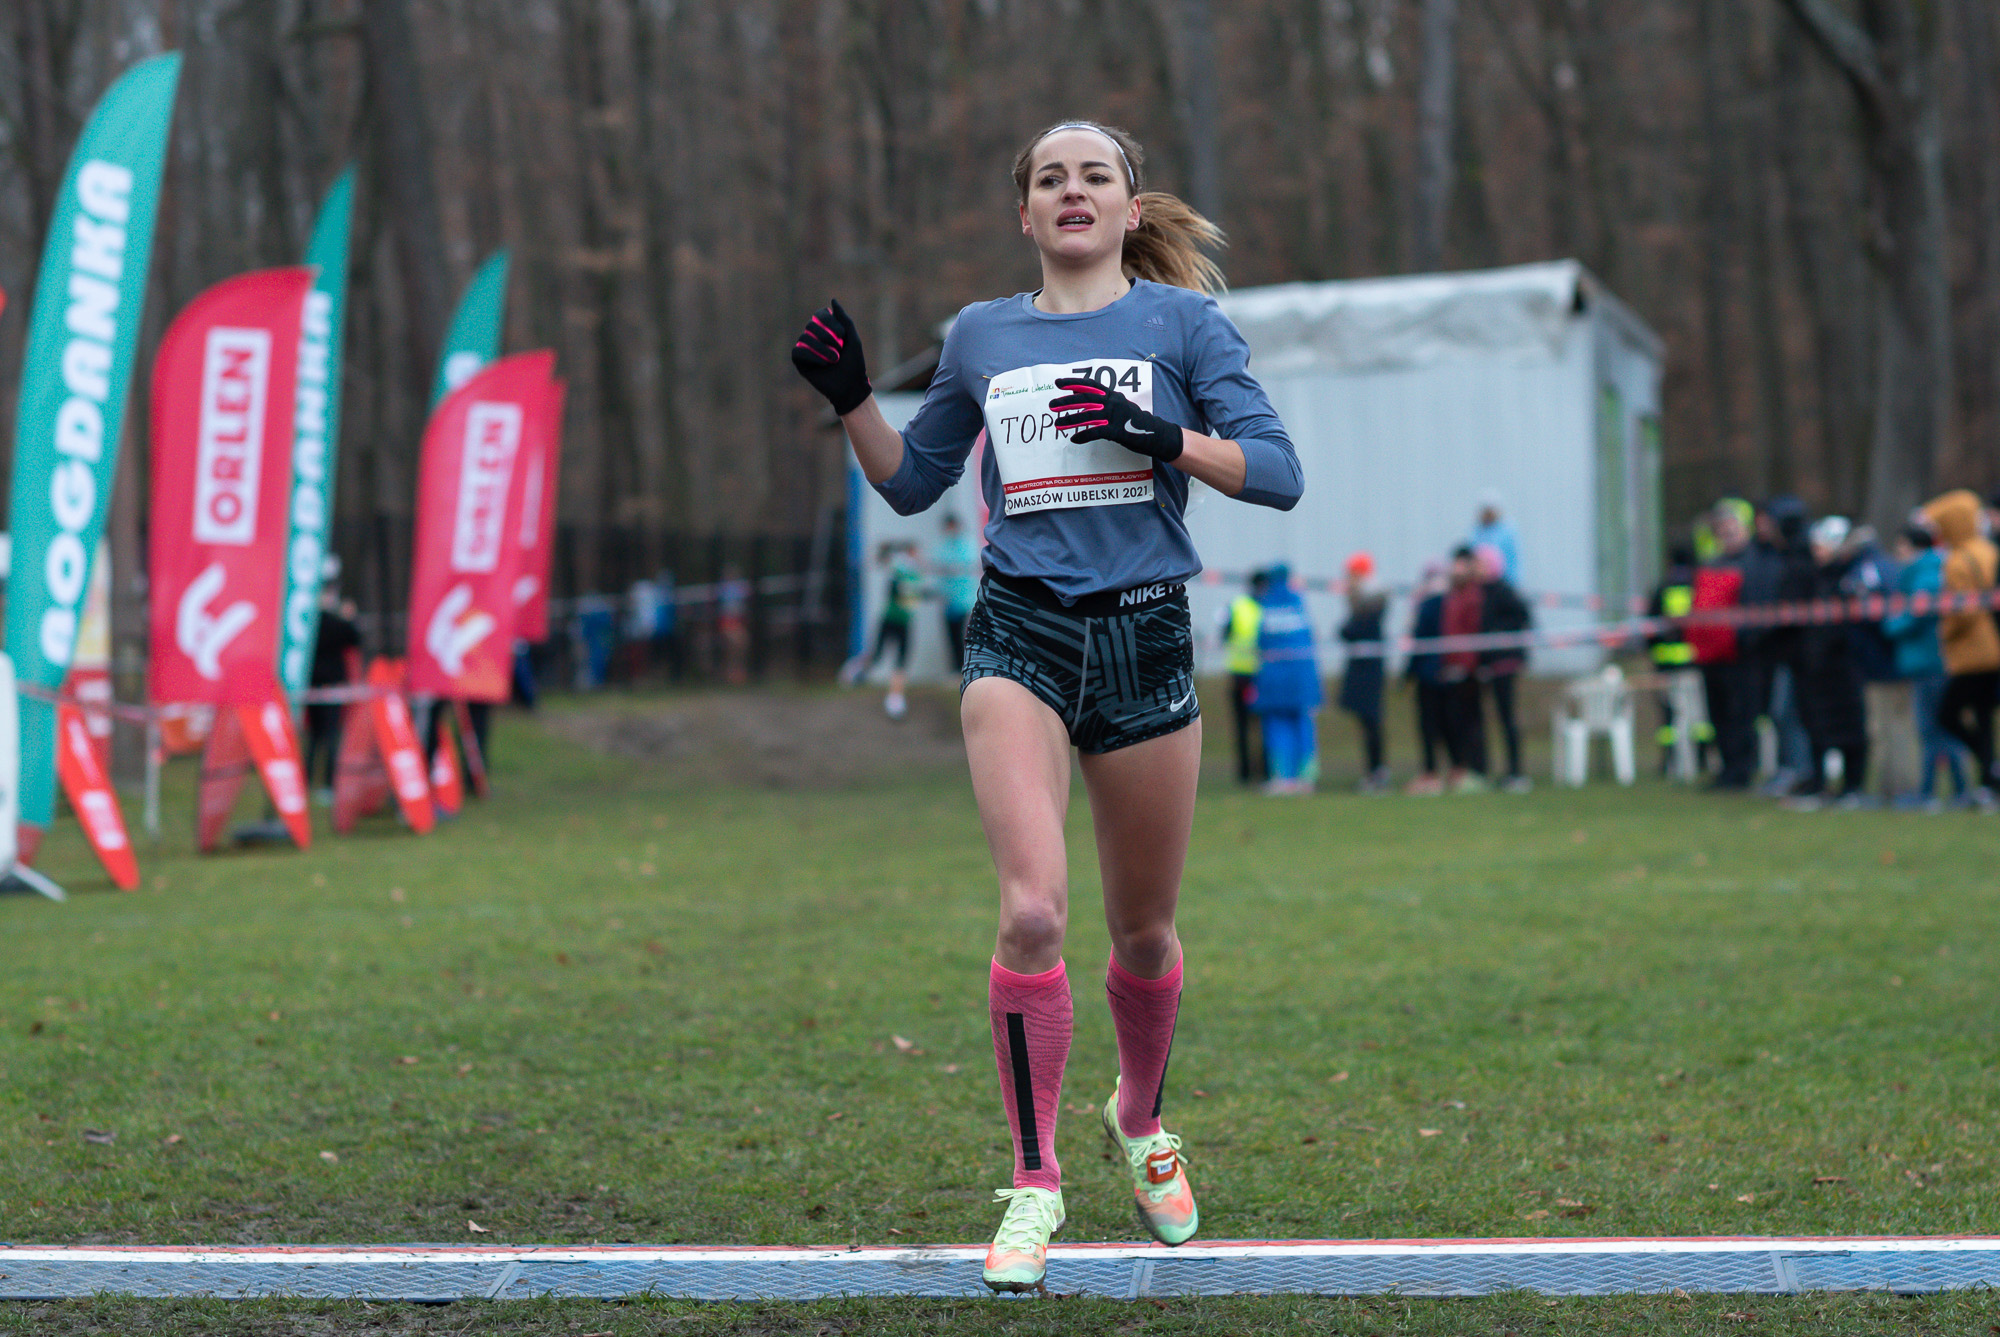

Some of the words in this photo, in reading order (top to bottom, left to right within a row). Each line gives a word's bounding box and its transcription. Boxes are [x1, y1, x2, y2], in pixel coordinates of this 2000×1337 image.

[1072, 366, 1142, 392] 704
[207, 345, 256, 529] ORLEN
[1007, 490, 1063, 510] OMASZÓW
[1067, 488, 1119, 502] LUBELSKI
[1122, 485, 1148, 498] 2021
[1119, 583, 1166, 607] NIKE
